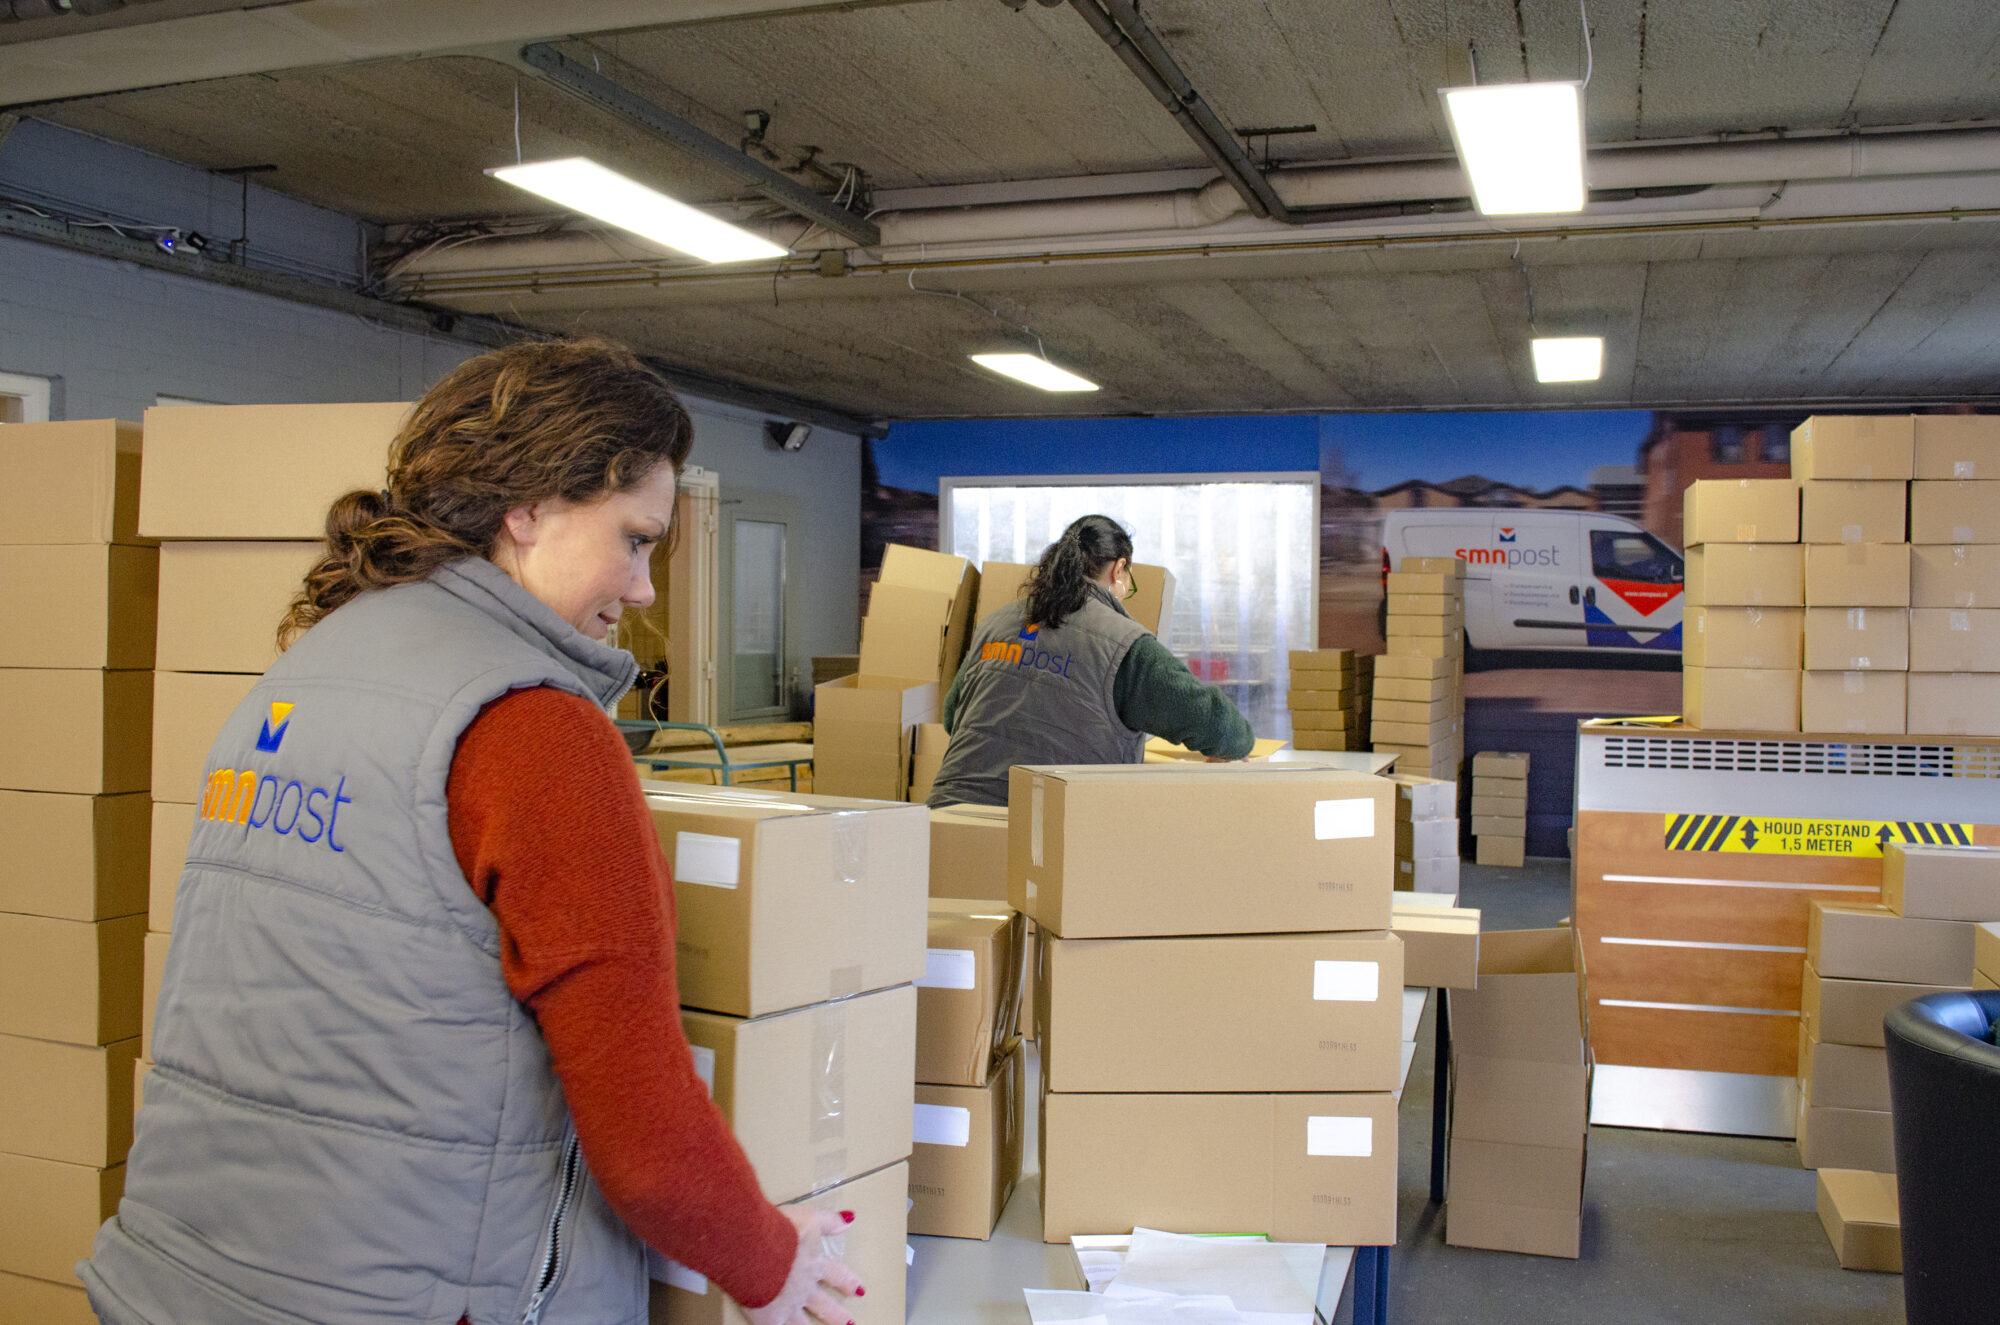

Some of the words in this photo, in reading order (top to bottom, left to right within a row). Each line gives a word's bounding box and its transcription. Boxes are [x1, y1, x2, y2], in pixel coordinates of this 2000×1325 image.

[1456, 545, 1561, 570] smnpost
[981, 641, 1075, 679] smnpost
[1764, 822, 1803, 835] HOUD
[1807, 824, 1871, 838] AFSTAND
[1780, 838, 1802, 851] 1,5
[1806, 838, 1853, 853] METER
